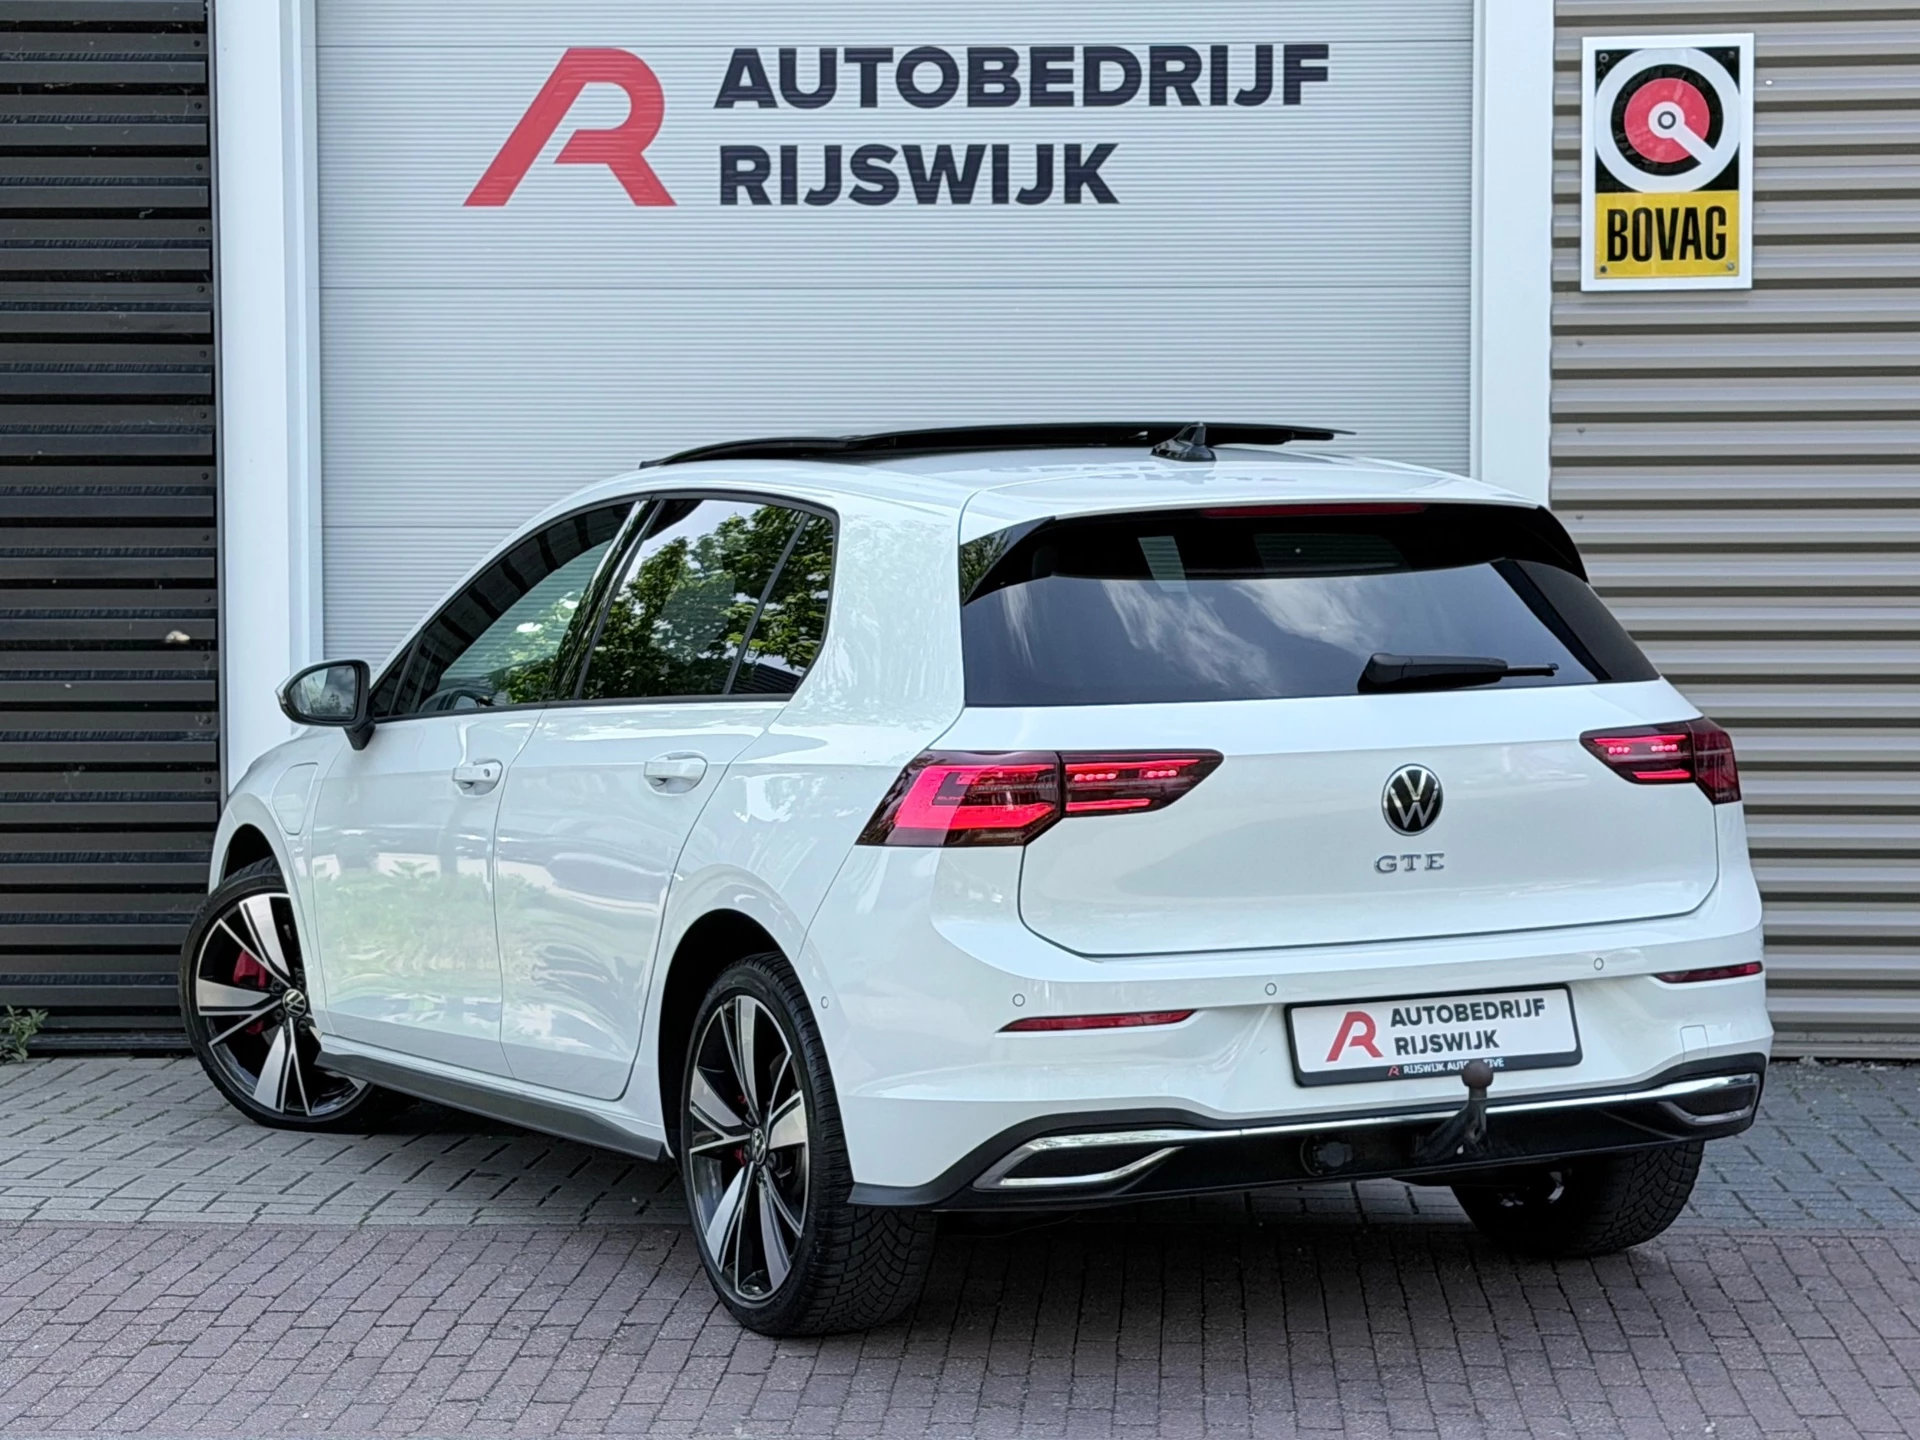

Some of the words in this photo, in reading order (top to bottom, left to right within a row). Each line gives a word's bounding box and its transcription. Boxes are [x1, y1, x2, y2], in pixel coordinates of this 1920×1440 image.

[714, 44, 1329, 109] AUTOBEDRIJF
[719, 143, 1120, 206] RIJSWIJK
[1607, 206, 1727, 262] BOVAG
[1374, 853, 1445, 873] GTE
[1390, 998, 1547, 1028] AUTOBEDRIJF
[1393, 1029, 1500, 1056] RIJSWIJK
[1403, 1062, 1445, 1074] RIJSWIJK
